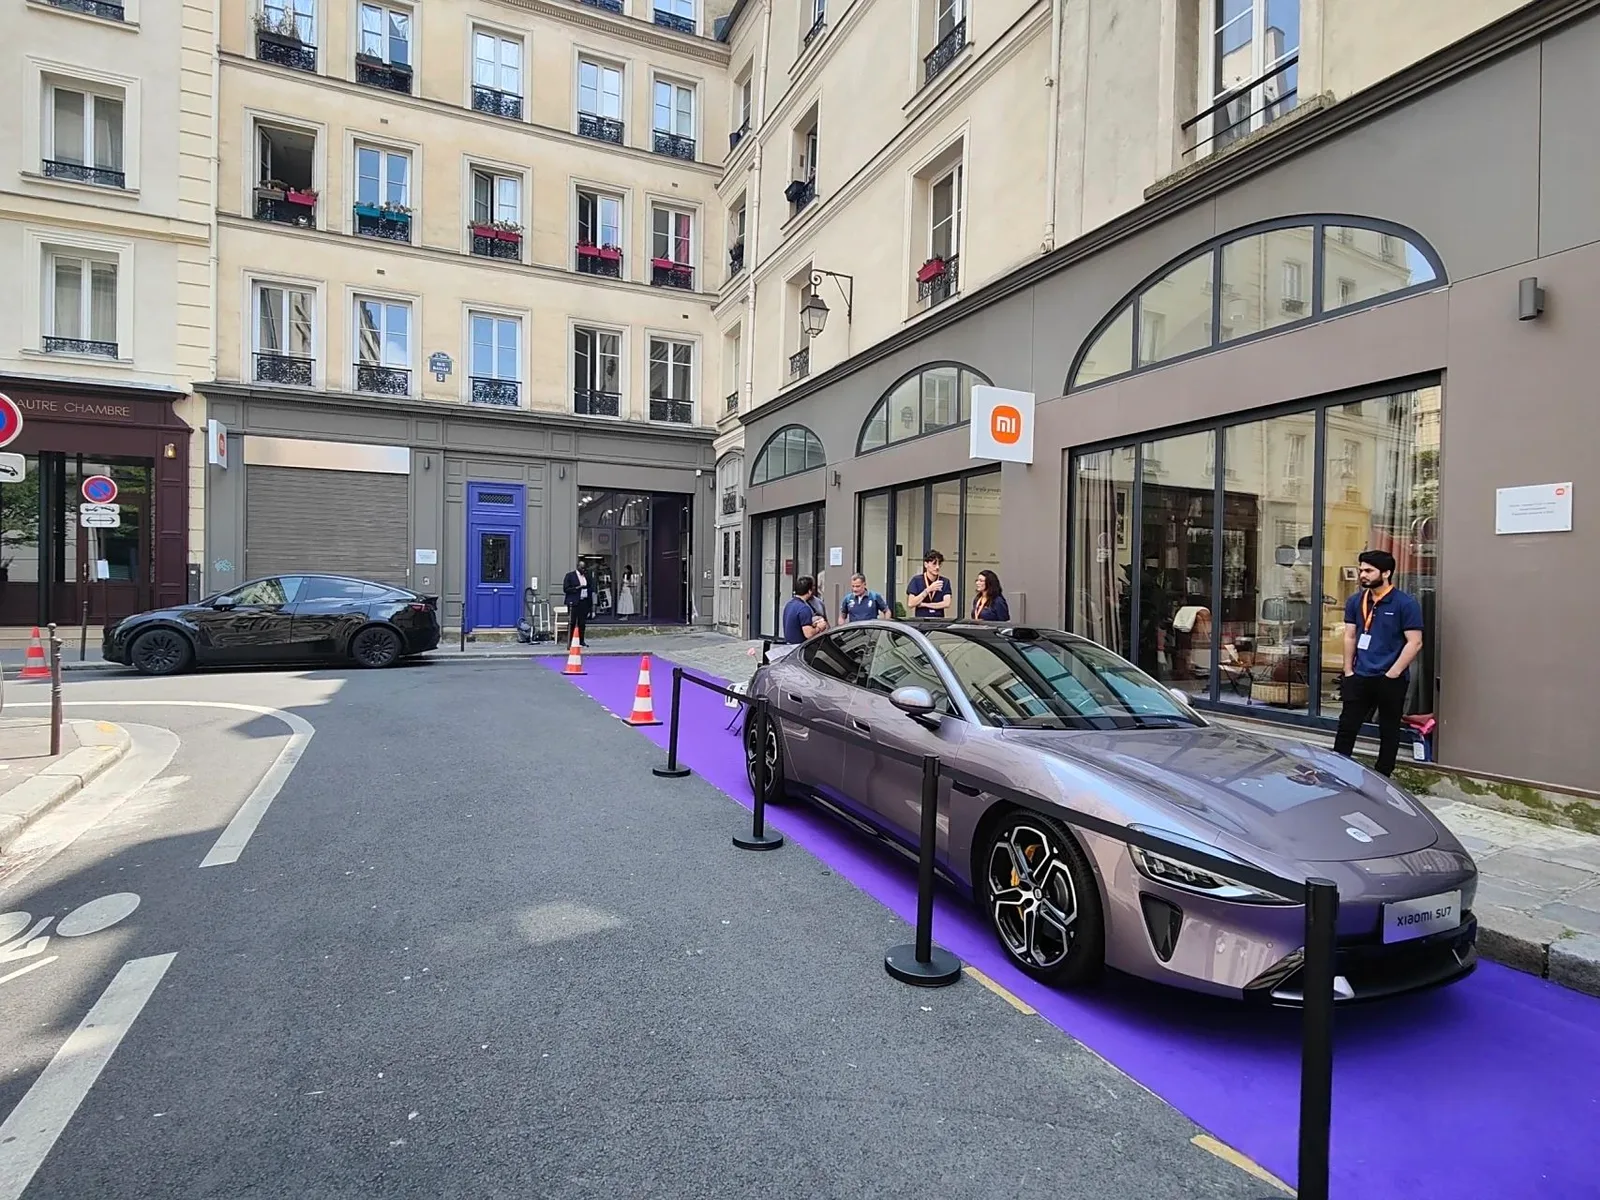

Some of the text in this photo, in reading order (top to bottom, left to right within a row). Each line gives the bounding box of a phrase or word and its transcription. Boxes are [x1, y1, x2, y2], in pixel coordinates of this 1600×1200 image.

[437, 373, 443, 381] 5
[17, 399, 130, 416] AUTRE CHAMBRE
[1436, 906, 1452, 919] SU7
